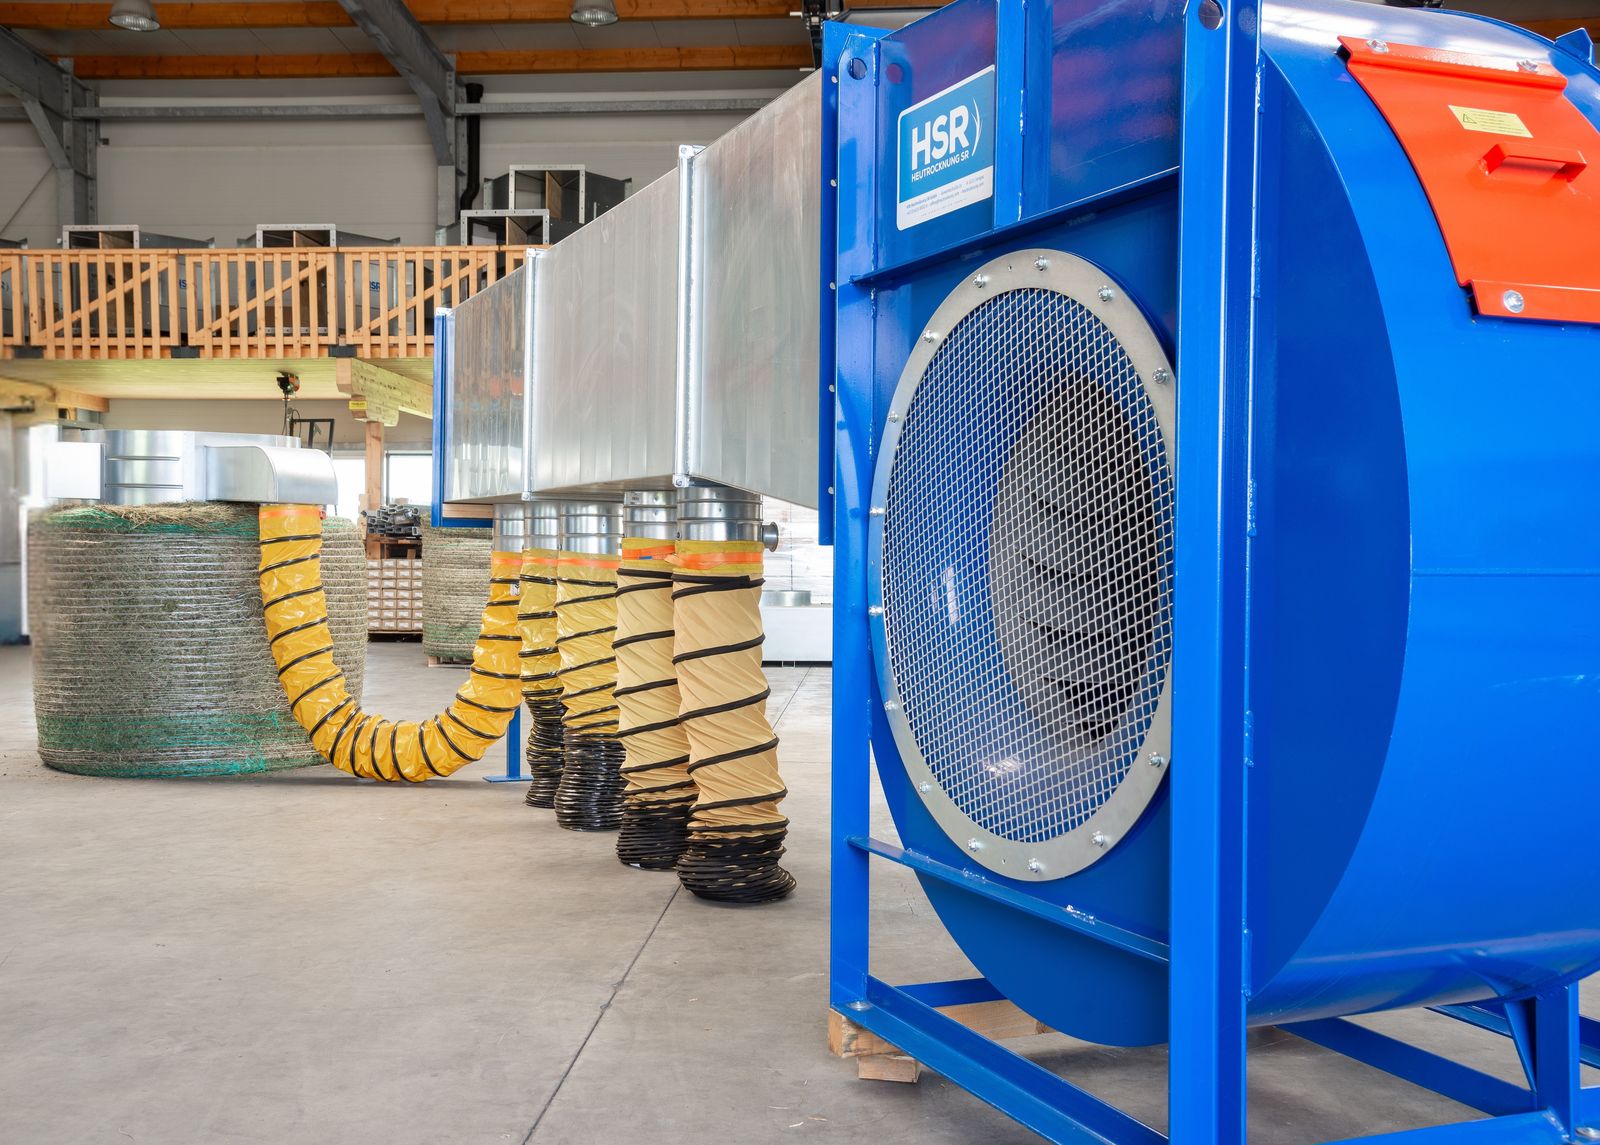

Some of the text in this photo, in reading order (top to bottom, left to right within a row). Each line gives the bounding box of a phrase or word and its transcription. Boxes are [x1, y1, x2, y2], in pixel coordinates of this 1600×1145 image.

[911, 105, 969, 171] HSR
[911, 150, 970, 182] HEUTROCKNUNG SR
